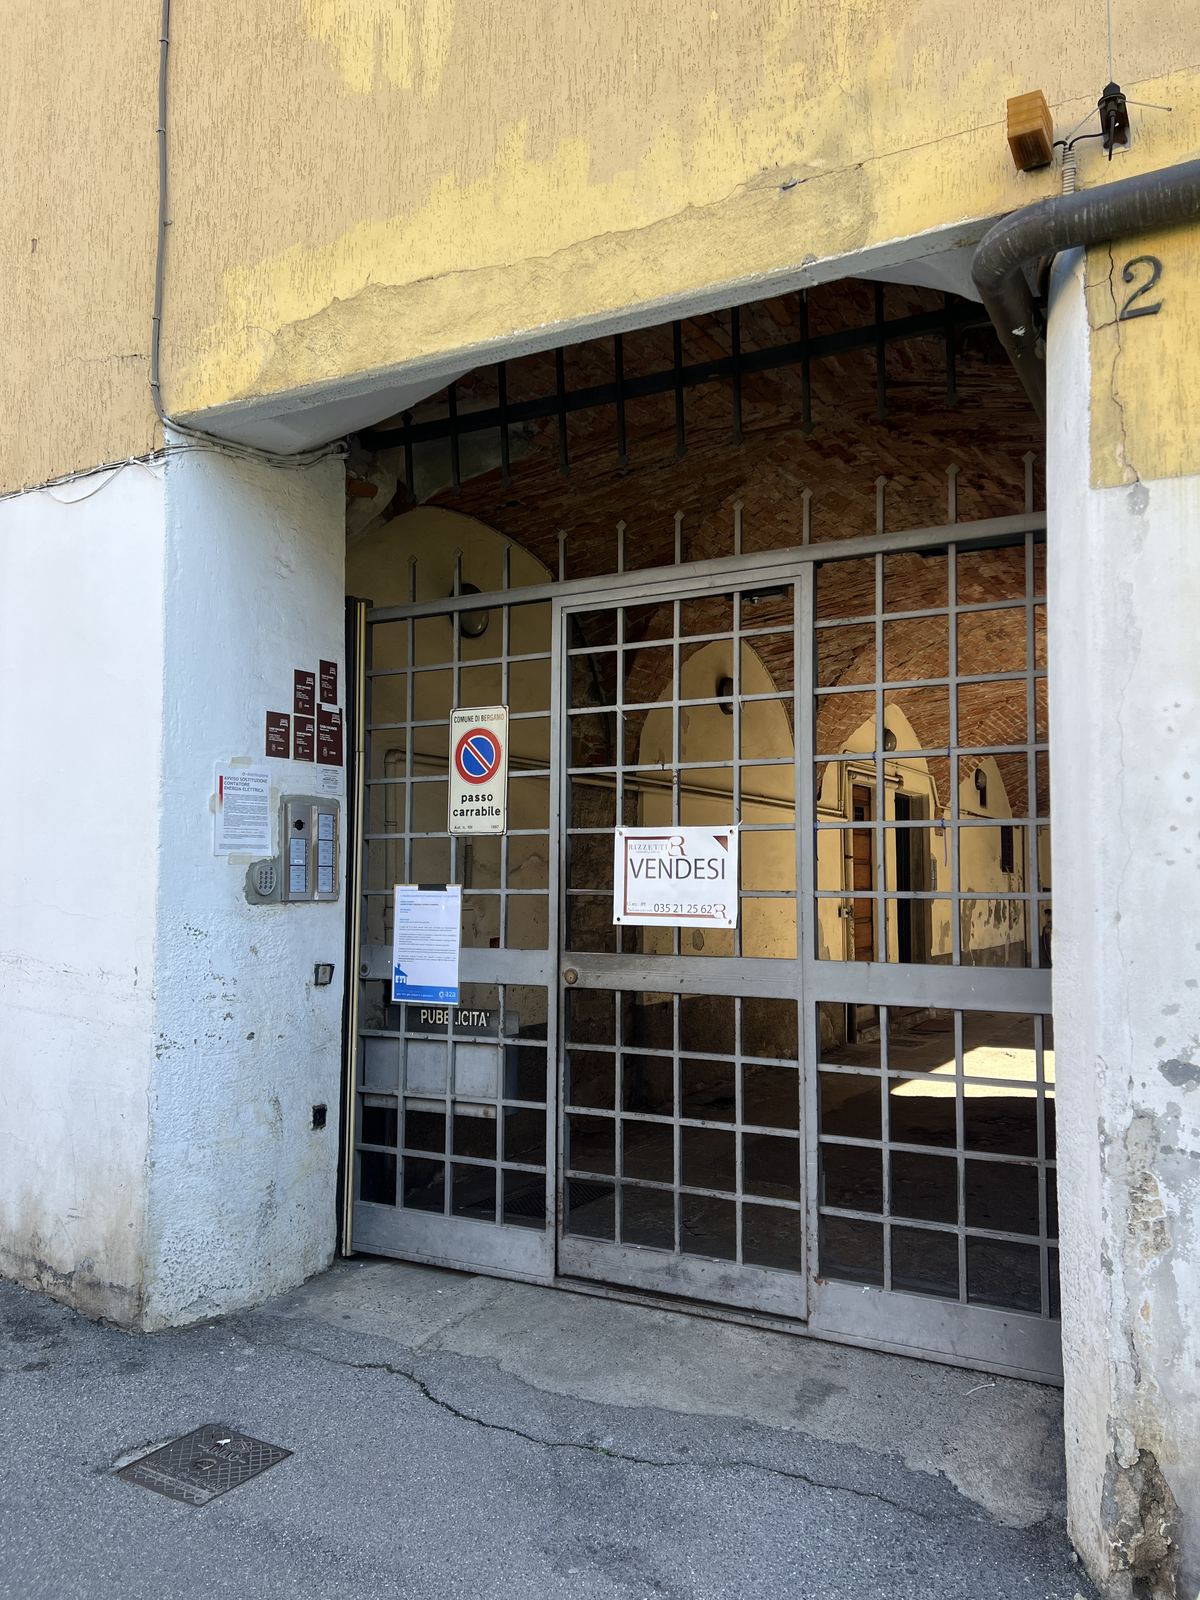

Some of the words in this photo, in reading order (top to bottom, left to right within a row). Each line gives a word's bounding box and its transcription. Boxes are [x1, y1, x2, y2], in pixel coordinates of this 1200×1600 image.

[1119, 254, 1163, 322] 2
[453, 715, 474, 724] COMUNE
[474, 714, 481, 722] DI
[481, 713, 505, 722] BERGAMO
[460, 793, 494, 804] passo
[453, 806, 501, 817] carrabile
[629, 843, 668, 851] RIZZETTI
[629, 858, 725, 880] VENDESI
[653, 903, 671, 913] 035
[673, 903, 684, 913] 21
[687, 904, 699, 914] 25
[700, 904, 713, 914] 62
